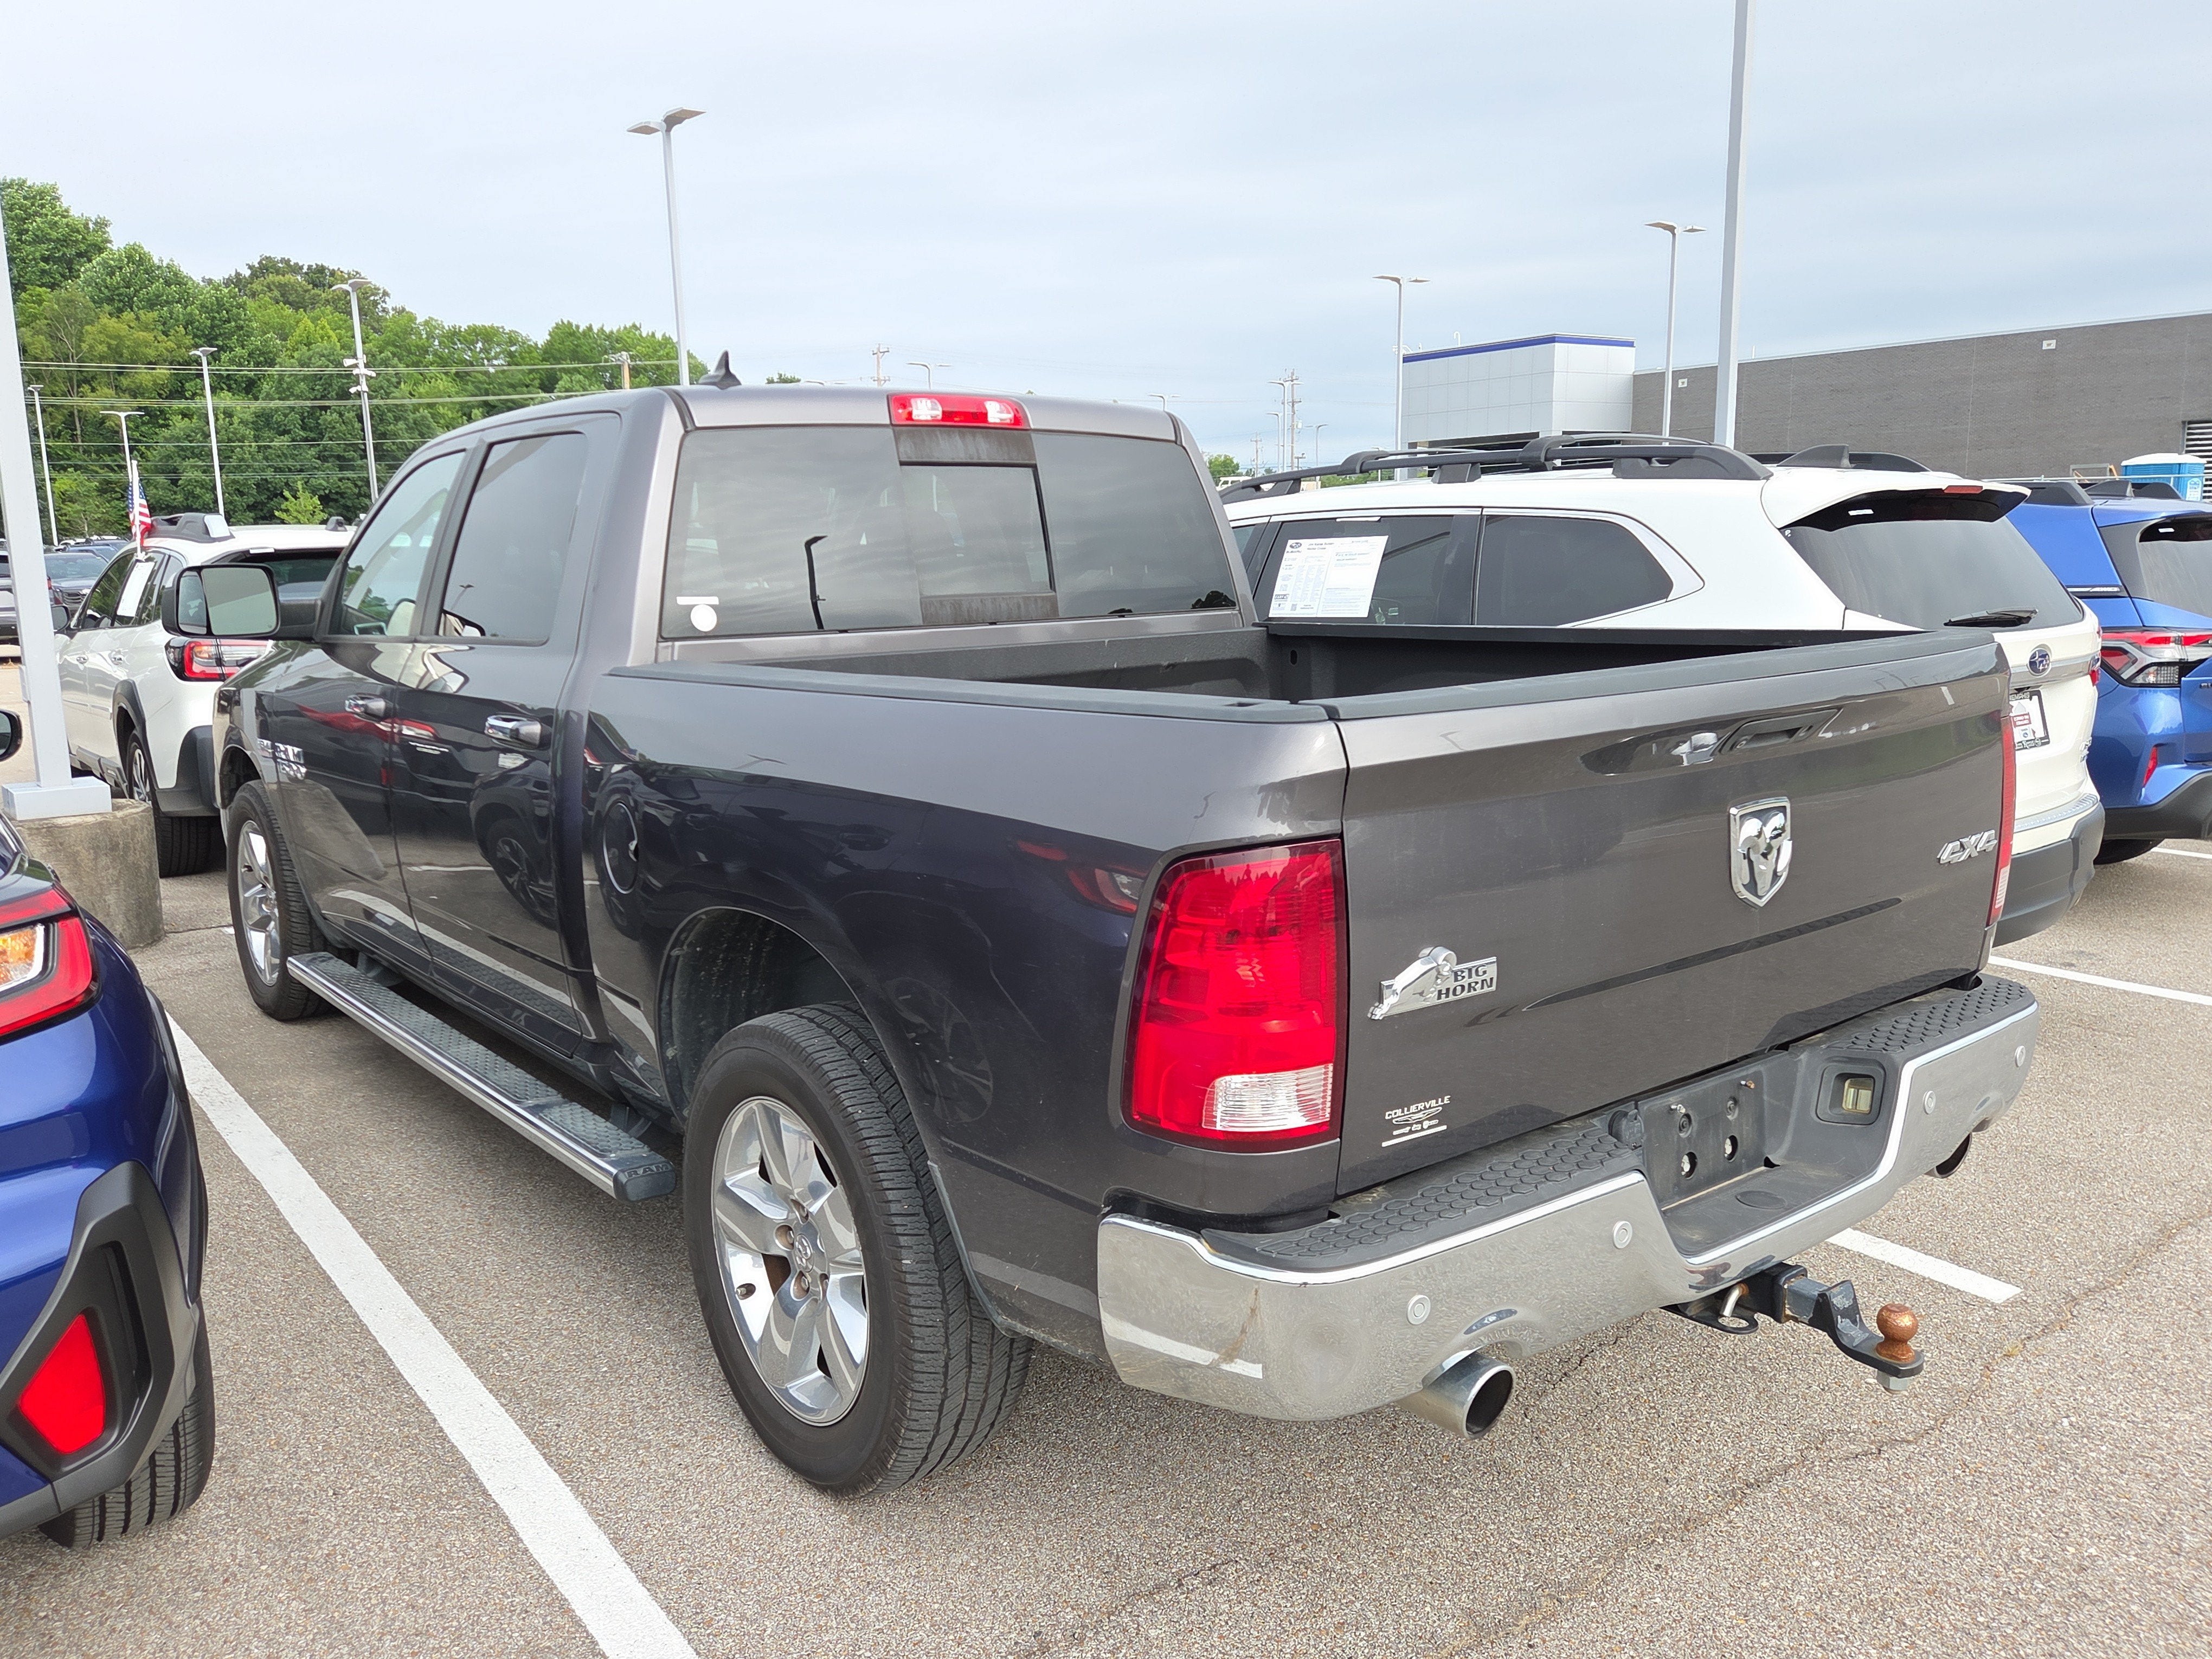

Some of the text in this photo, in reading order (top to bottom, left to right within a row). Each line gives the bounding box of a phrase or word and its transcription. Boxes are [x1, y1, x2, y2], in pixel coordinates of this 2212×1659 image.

[1937, 829, 1998, 864] 4X4
[1454, 964, 1487, 983] BIG
[1436, 976, 1494, 1001] HORN
[1385, 1095, 1451, 1120] COLLIERVILLE
